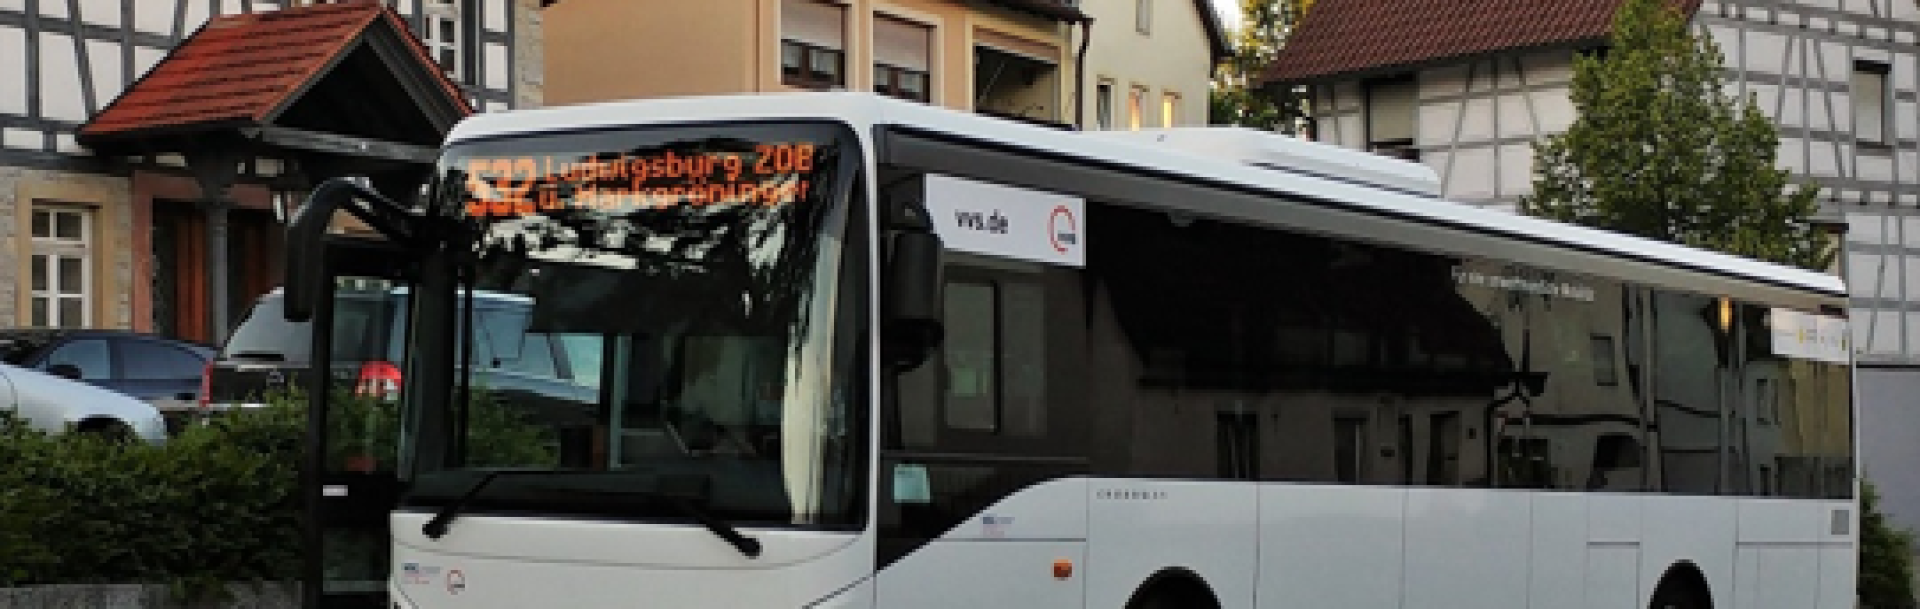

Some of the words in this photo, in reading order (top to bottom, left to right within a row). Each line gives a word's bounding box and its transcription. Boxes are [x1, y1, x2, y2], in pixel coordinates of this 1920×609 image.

[543, 153, 743, 182] Ludwigsburg
[754, 142, 814, 175] ZOB
[954, 209, 1009, 235] vvs.de
